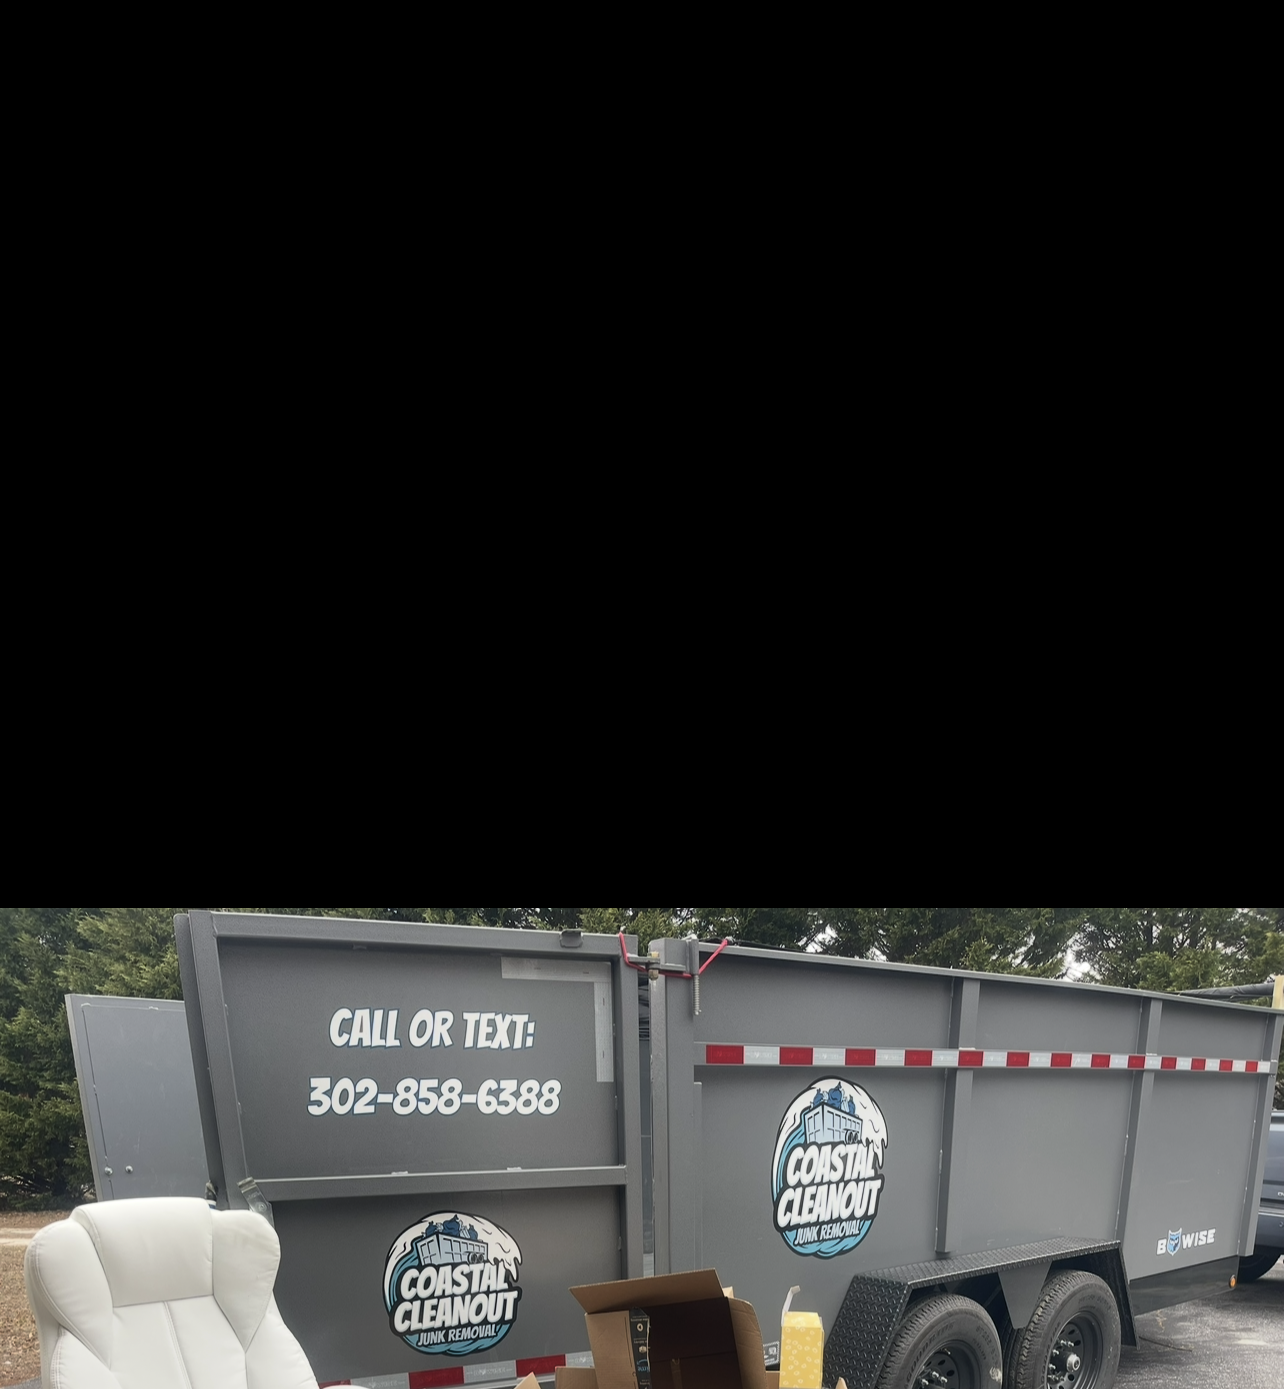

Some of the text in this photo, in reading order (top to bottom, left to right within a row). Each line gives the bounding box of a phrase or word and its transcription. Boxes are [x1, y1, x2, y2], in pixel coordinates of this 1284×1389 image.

[329, 1007, 536, 1050] CALL OR TEXT:
[307, 1076, 562, 1117] 302-858-6388
[786, 1142, 876, 1187] COASTAL
[777, 1178, 882, 1228] CLEANOUT
[794, 1219, 860, 1245] JUNK REMOVAL
[400, 1261, 509, 1300] COASTAL
[393, 1290, 518, 1333] CLEANOUT
[418, 1324, 497, 1346] JUNK REMOVAL
